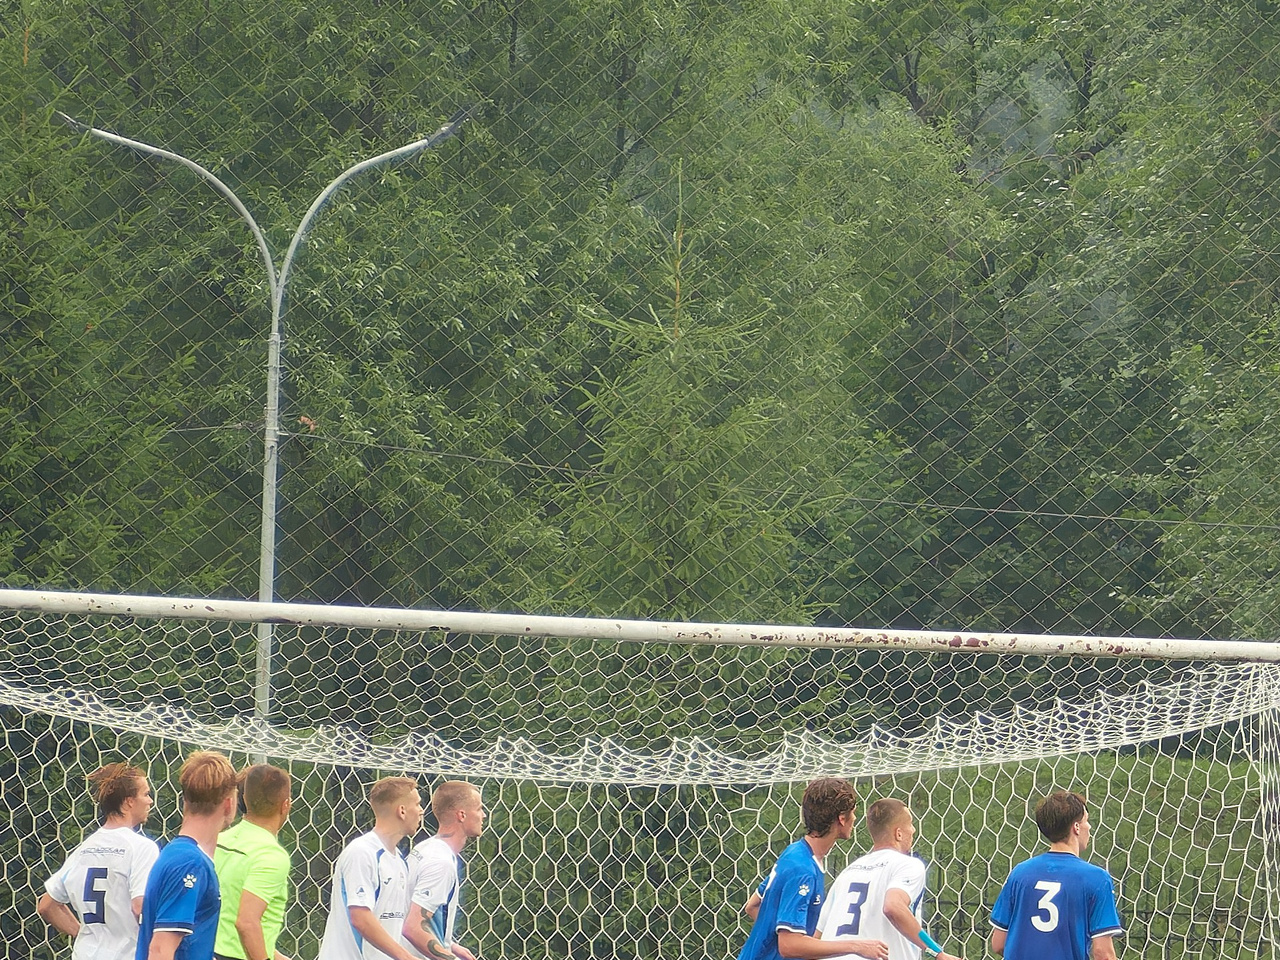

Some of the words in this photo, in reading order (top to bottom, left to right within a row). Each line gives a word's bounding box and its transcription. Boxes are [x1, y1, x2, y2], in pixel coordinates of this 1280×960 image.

[83, 867, 108, 925] 5
[835, 882, 870, 936] 3
[1031, 880, 1062, 932] 3
